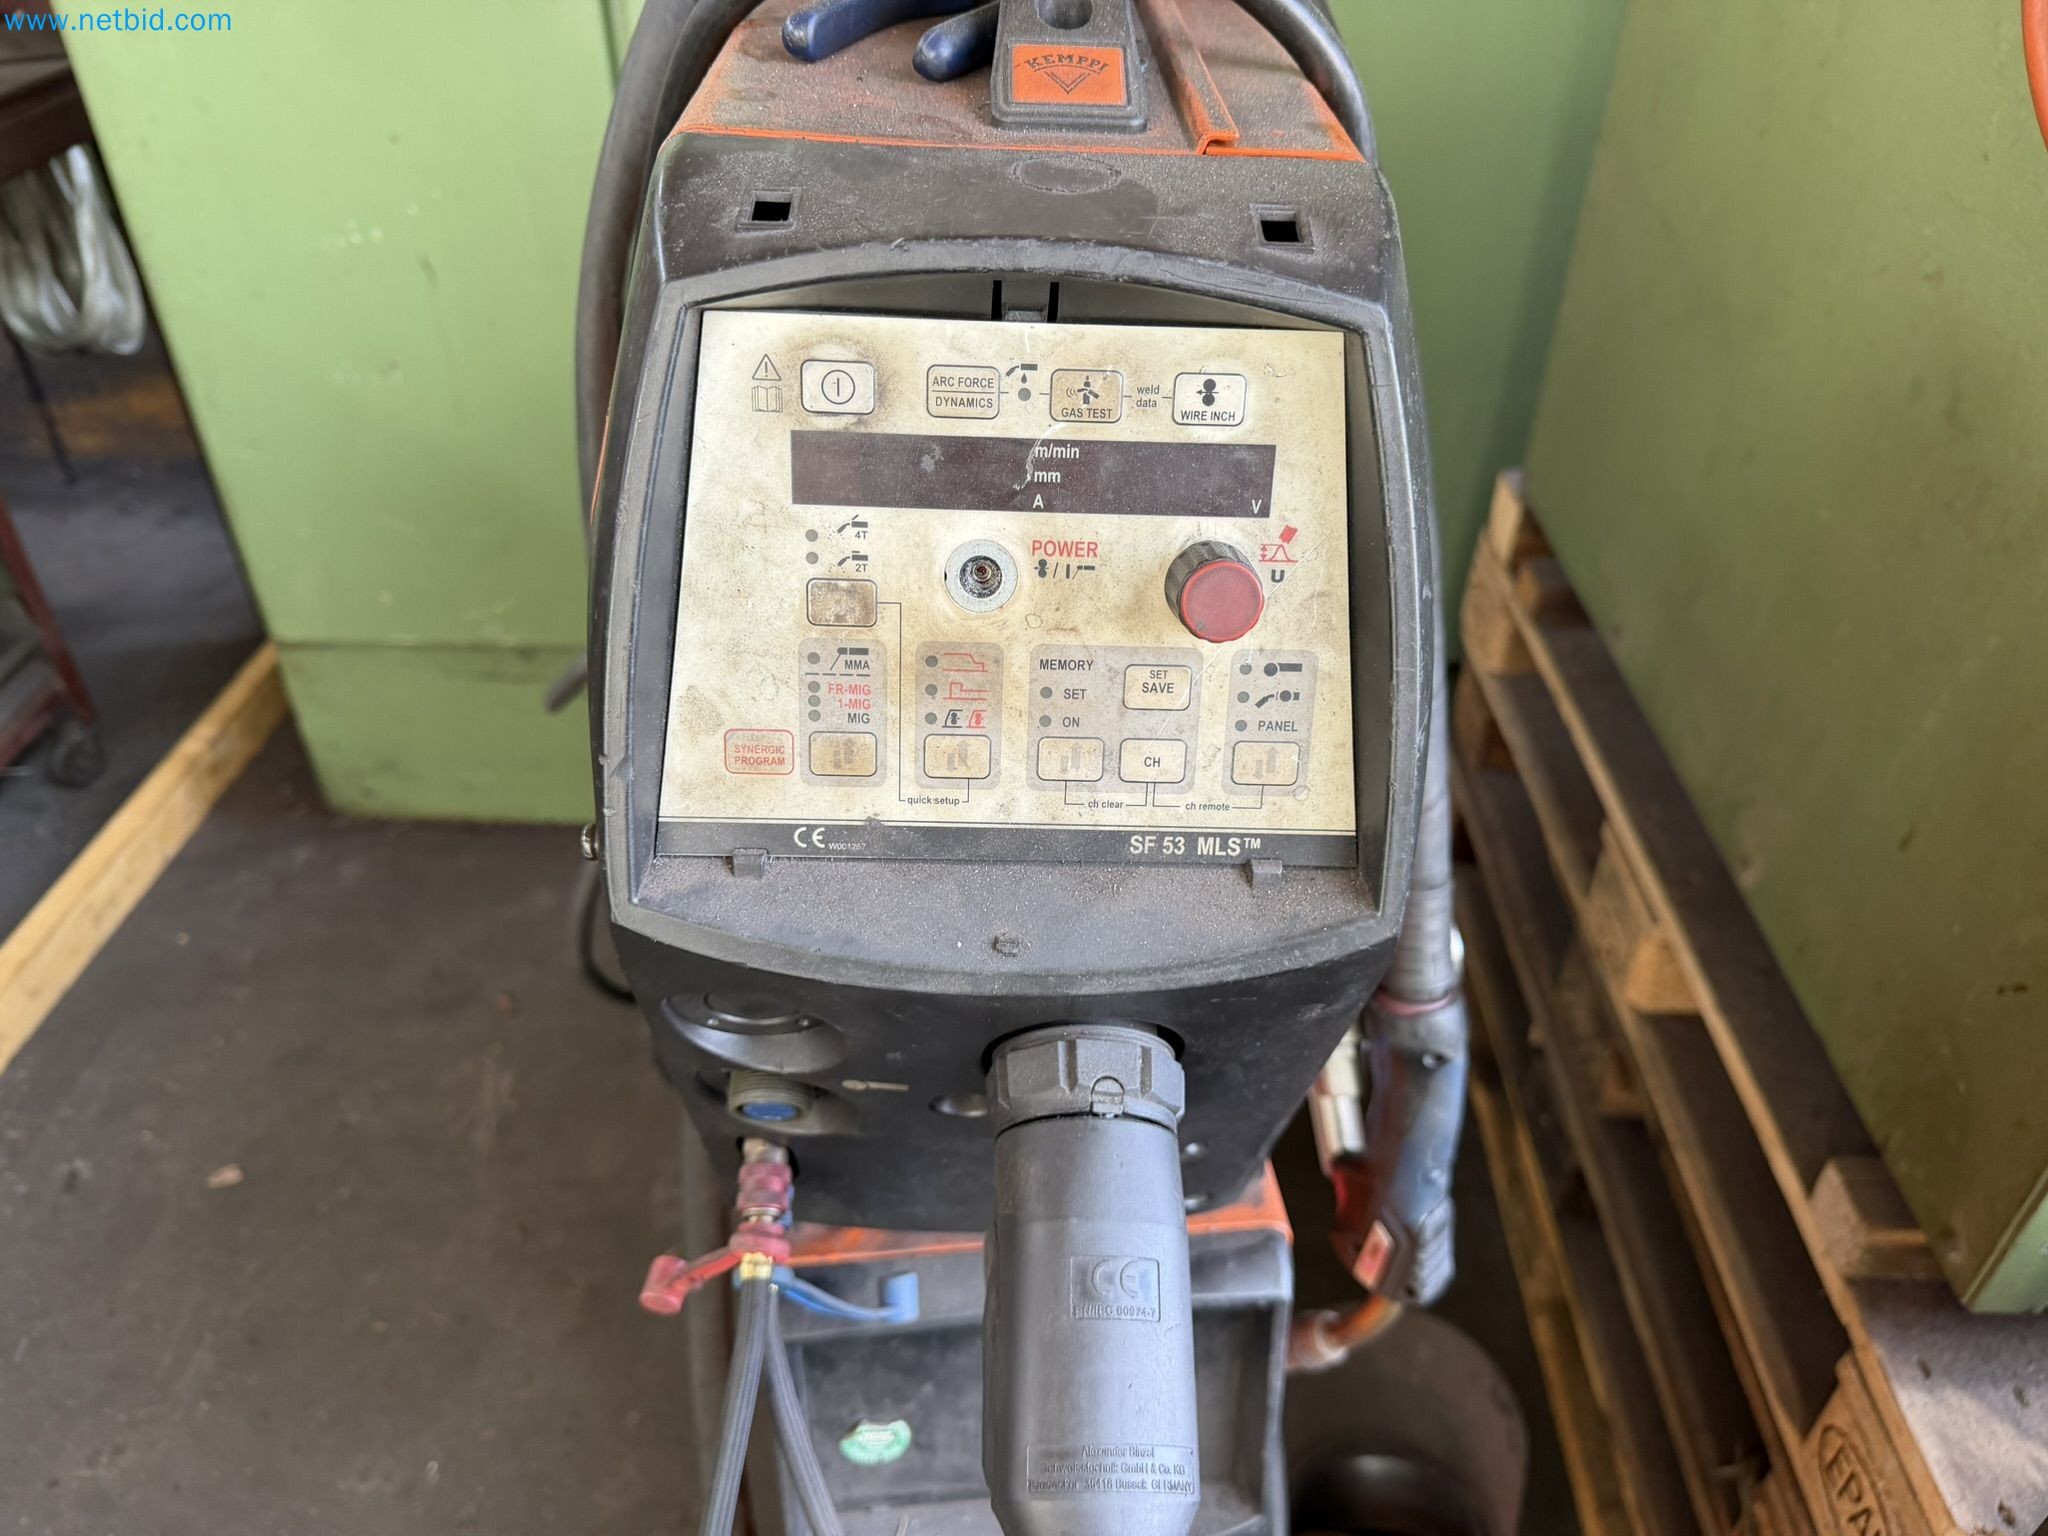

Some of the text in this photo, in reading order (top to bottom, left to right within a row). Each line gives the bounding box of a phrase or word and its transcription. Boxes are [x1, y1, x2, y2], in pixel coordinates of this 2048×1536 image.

[1024, 54, 1110, 72] KEMPPI
[932, 376, 995, 389] ARC FORCE
[1136, 384, 1160, 396] weld
[935, 396, 994, 409] DYNAMICS
[1136, 397, 1157, 408] data
[1061, 407, 1113, 419] GAS TEST
[1180, 410, 1236, 422] WIRE INCH
[1034, 444, 1080, 459] m/min
[1034, 471, 1061, 483] mm
[1033, 494, 1044, 509] A
[1251, 500, 1262, 514] V
[854, 530, 868, 540] 4T
[1032, 540, 1099, 558] POWER
[855, 563, 868, 573] 2T
[1271, 569, 1285, 583] U
[844, 660, 871, 671] MMA
[1039, 659, 1094, 672] MEMORY
[1149, 669, 1169, 680] SET
[828, 683, 871, 696] FR-MIG
[1141, 682, 1175, 694] SAVE
[1063, 689, 1087, 700] SET
[838, 699, 871, 710] 1-MIG
[847, 713, 870, 724] MIG
[1062, 717, 1081, 728] ON
[1257, 720, 1299, 732] PANEL
[734, 745, 785, 755] SYNERGIC
[734, 756, 786, 766] PROGRAM
[1144, 756, 1161, 768] CH
[907, 795, 960, 807] quick setup
[1088, 800, 1124, 809] ch clear
[1185, 802, 1231, 812] ch remote
[794, 827, 825, 848] CE
[1130, 835, 1156, 855] SF
[1162, 836, 1185, 855] 53
[1121, 1462, 1149, 1474] GmbH
[1173, 1464, 1186, 1476] KG
